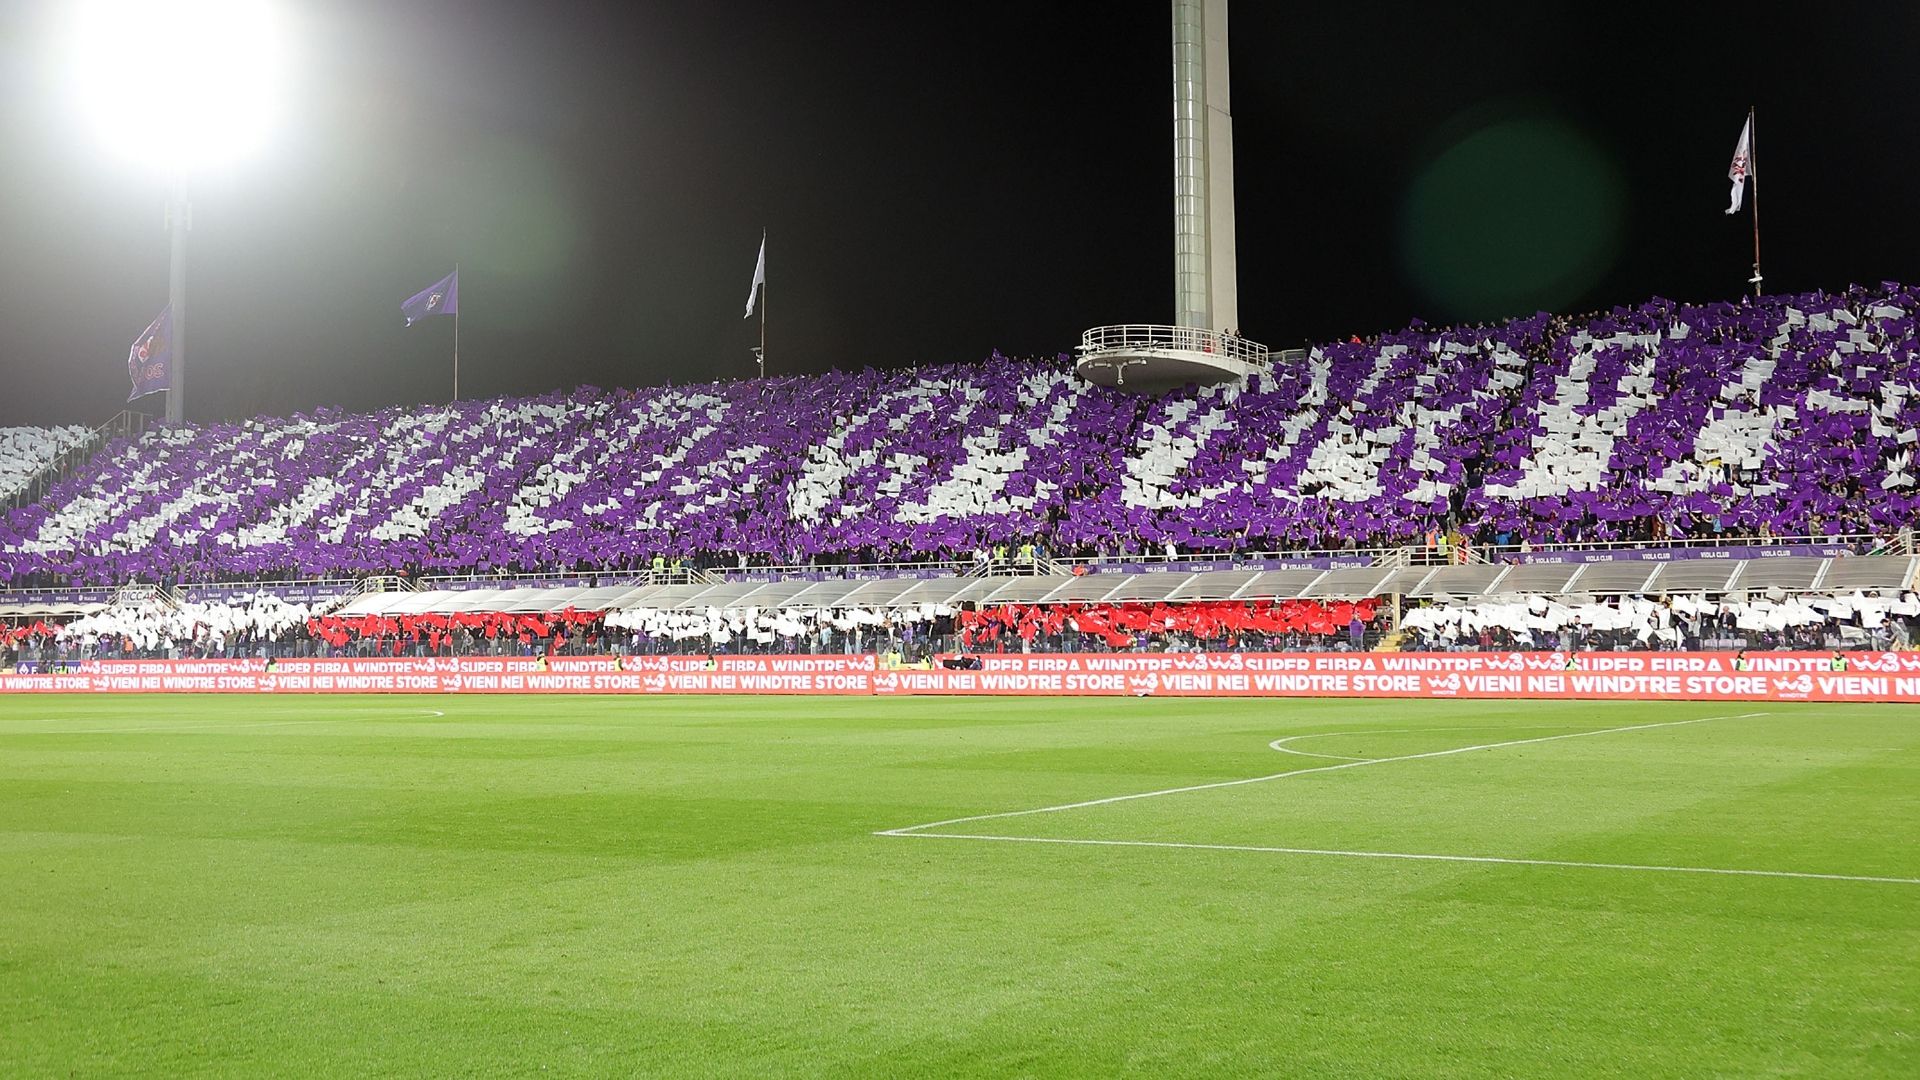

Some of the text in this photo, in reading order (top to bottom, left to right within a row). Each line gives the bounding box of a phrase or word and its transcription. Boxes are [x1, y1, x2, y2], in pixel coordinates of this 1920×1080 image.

[1600, 554, 1612, 562] CLUB
[102, 664, 228, 674] SUPER FIBRA WINDTRE
[314, 662, 349, 672] FIBRA
[354, 662, 412, 672] WINDTRE
[460, 661, 615, 672] SUPER FIBR WINDTRE
[722, 660, 767, 671] FIBRA
[772, 660, 846, 671] WINDTRE
[1028, 659, 1080, 671] FIBRA
[1086, 659, 1172, 670] WINDTRE
[1246, 658, 1482, 670] SUPER FIBRA WINDTRE
[1651, 658, 1722, 671] FIBRA
[5, 677, 90, 689] WINDTRE STORE
[111, 676, 256, 688] VIENI NEI WINDTRE STORE
[278, 676, 438, 688] VIENI NEI WINDTRE STORE
[463, 676, 640, 688] VIENI NEI WINDTRE STORE
[668, 675, 867, 689] VIENI NEI WINDTRE STORE
[900, 674, 1124, 689] VIENI NEI WINDTRE STORE
[1161, 674, 1420, 691] VIENI NEI WINDTRE STORE
[1462, 675, 1767, 694] VIENI NEI WINDTRE STORE
[1817, 677, 1888, 695] VIENI
